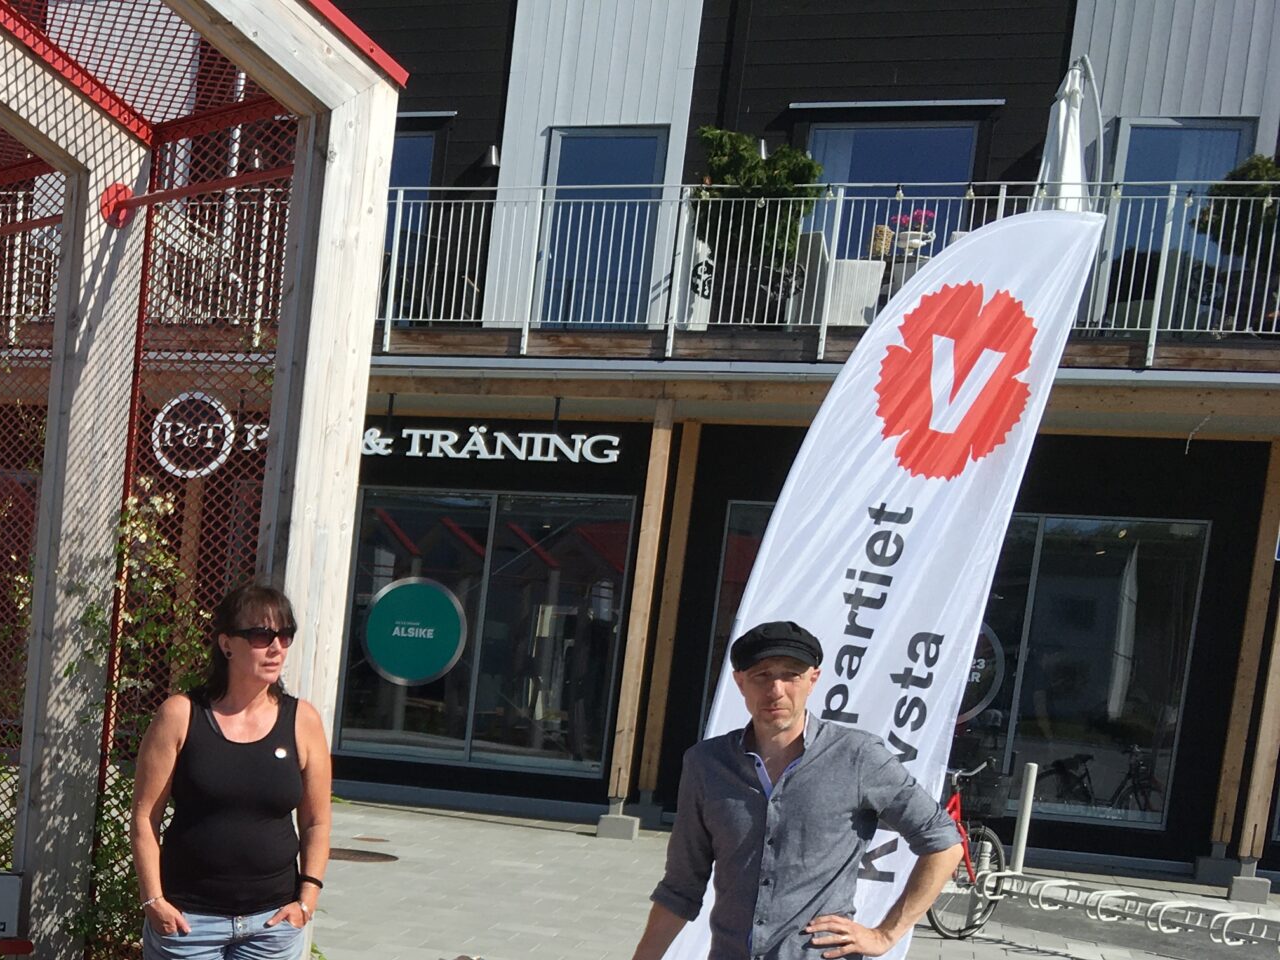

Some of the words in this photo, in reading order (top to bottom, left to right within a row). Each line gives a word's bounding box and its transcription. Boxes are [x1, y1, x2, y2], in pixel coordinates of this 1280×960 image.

[929, 334, 1006, 434] V
[360, 427, 394, 456] &
[402, 426, 620, 464] TRÄNING
[391, 626, 435, 639] ALSIKE
